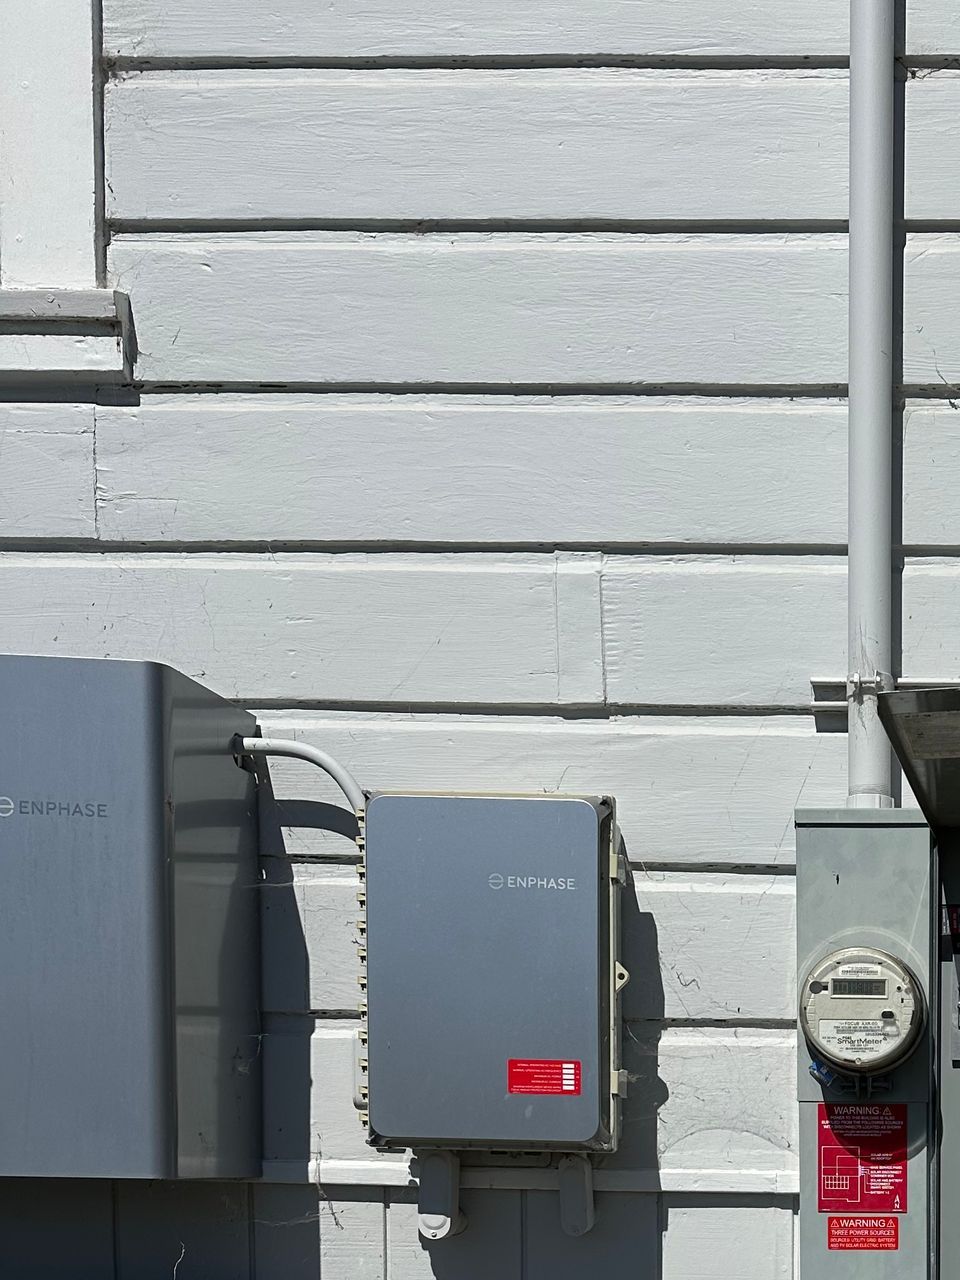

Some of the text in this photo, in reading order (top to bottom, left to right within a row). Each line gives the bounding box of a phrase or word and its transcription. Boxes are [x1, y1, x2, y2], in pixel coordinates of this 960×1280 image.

[19, 800, 108, 818] ENPHASE
[507, 875, 577, 890] ENPHASE
[834, 1106, 880, 1115] WARNING
[839, 1219, 886, 1227] WARNING
